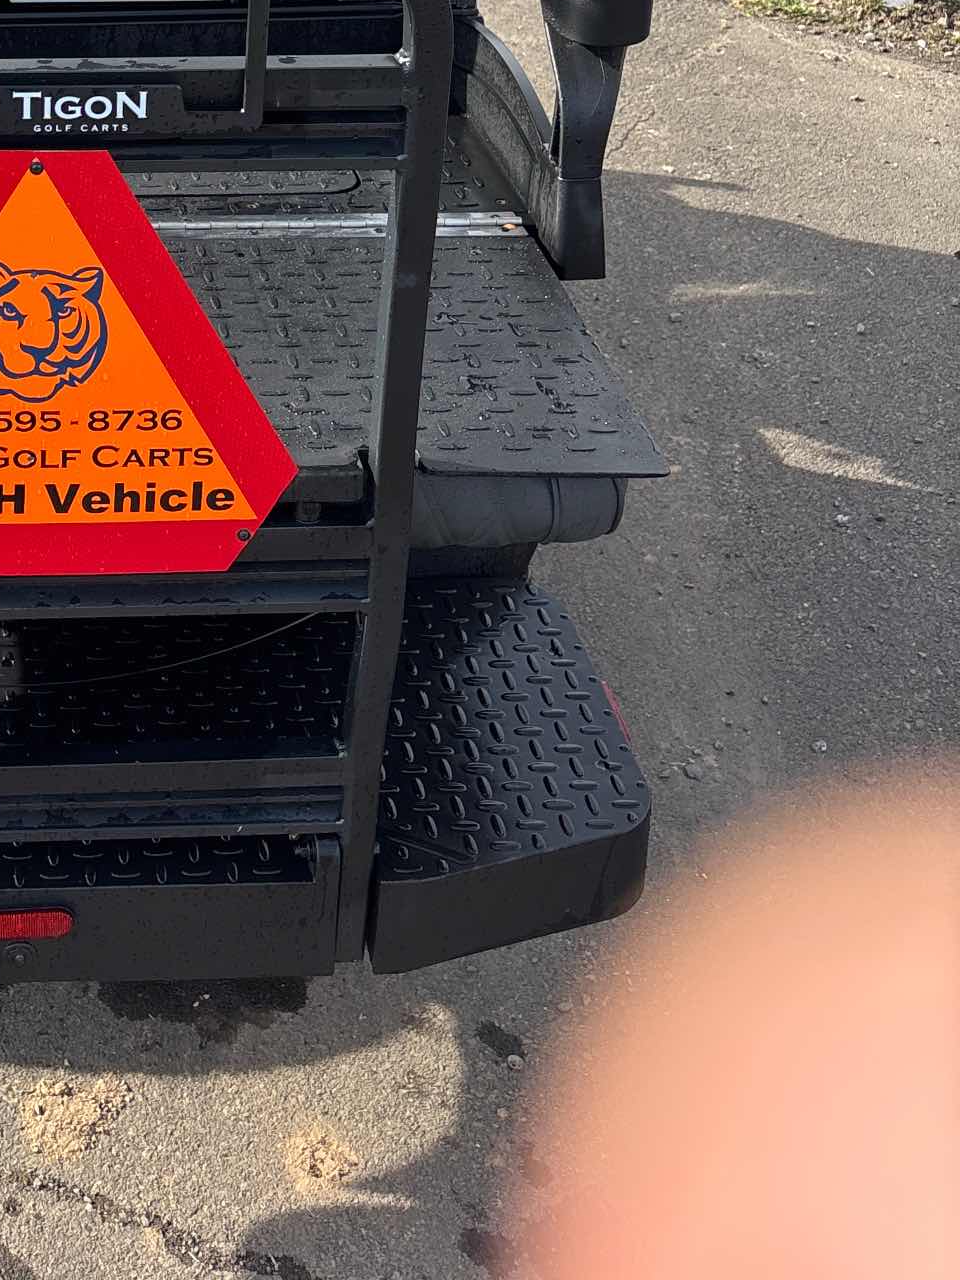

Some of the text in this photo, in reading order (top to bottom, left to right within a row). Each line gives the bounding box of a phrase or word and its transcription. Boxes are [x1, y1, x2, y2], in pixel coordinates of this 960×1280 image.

[12, 91, 148, 120] TIGON
[33, 124, 129, 133] GOLF CARTS
[91, 445, 214, 468] CARTS
[45, 481, 235, 514] Vehicle
